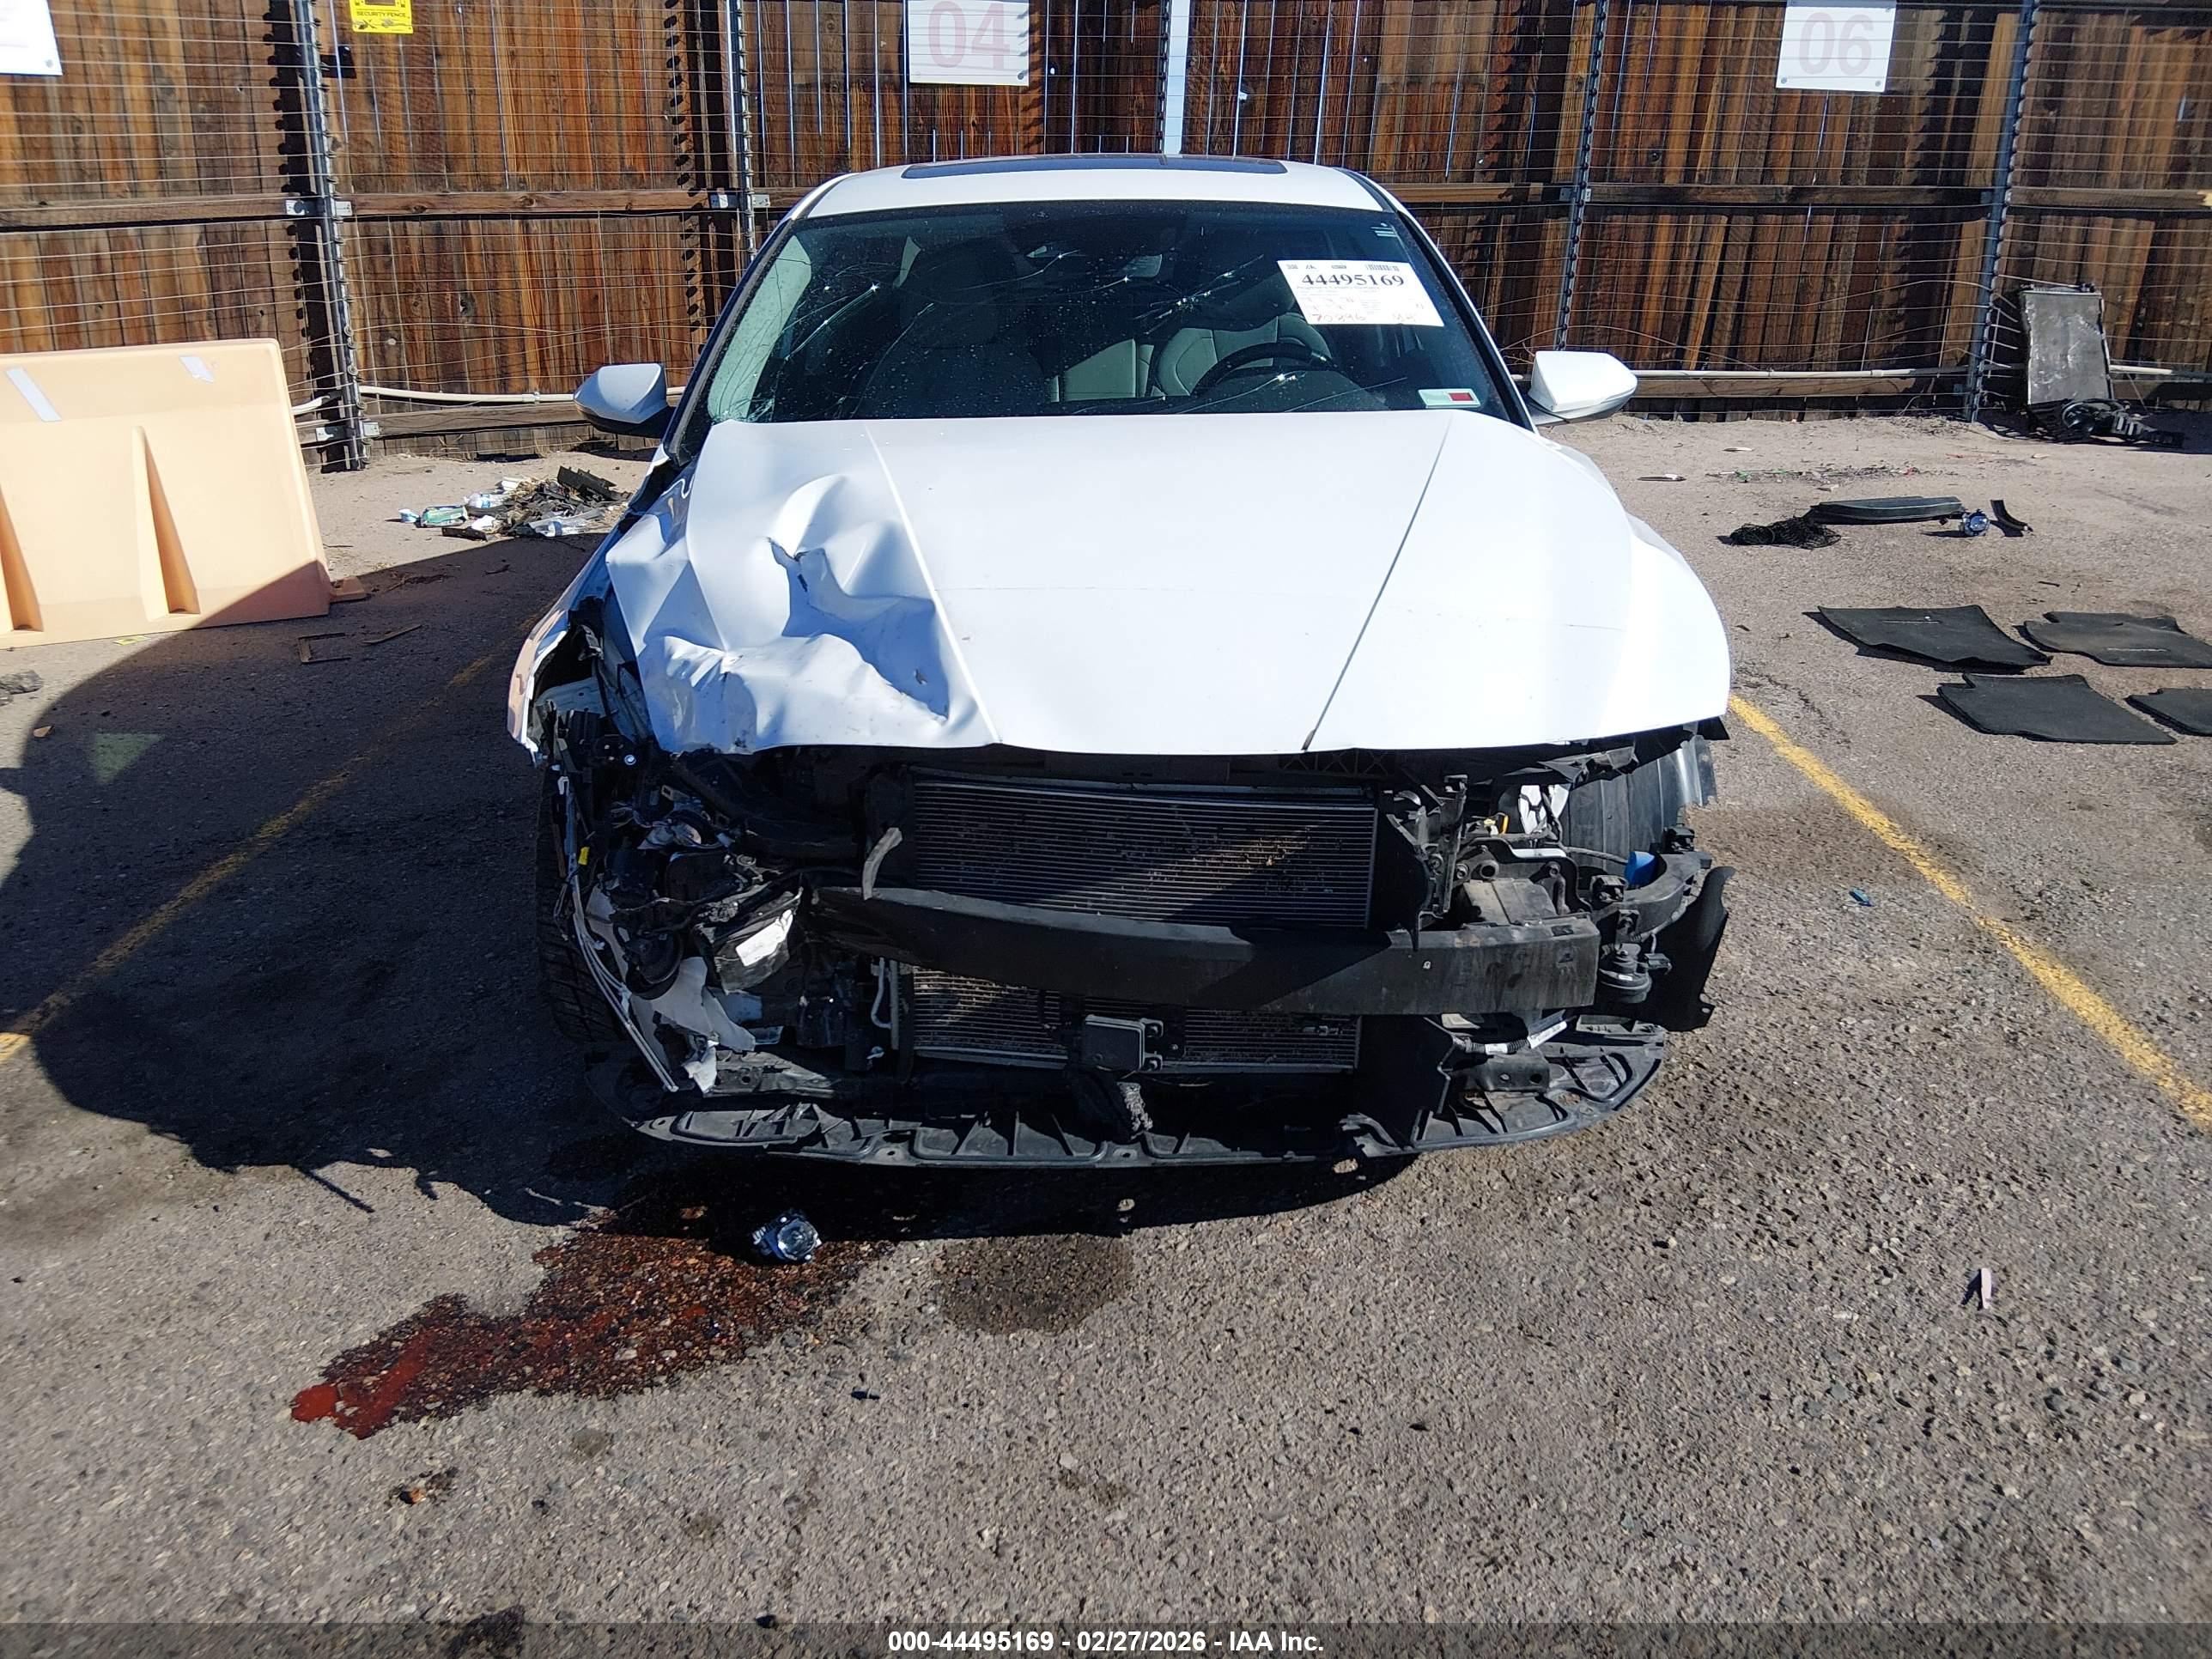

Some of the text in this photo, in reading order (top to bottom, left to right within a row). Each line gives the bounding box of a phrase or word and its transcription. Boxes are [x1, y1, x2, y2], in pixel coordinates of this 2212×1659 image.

[928, 1, 1011, 69] 04
[1799, 12, 1874, 76] 06
[1302, 274, 1405, 287] 44495169
